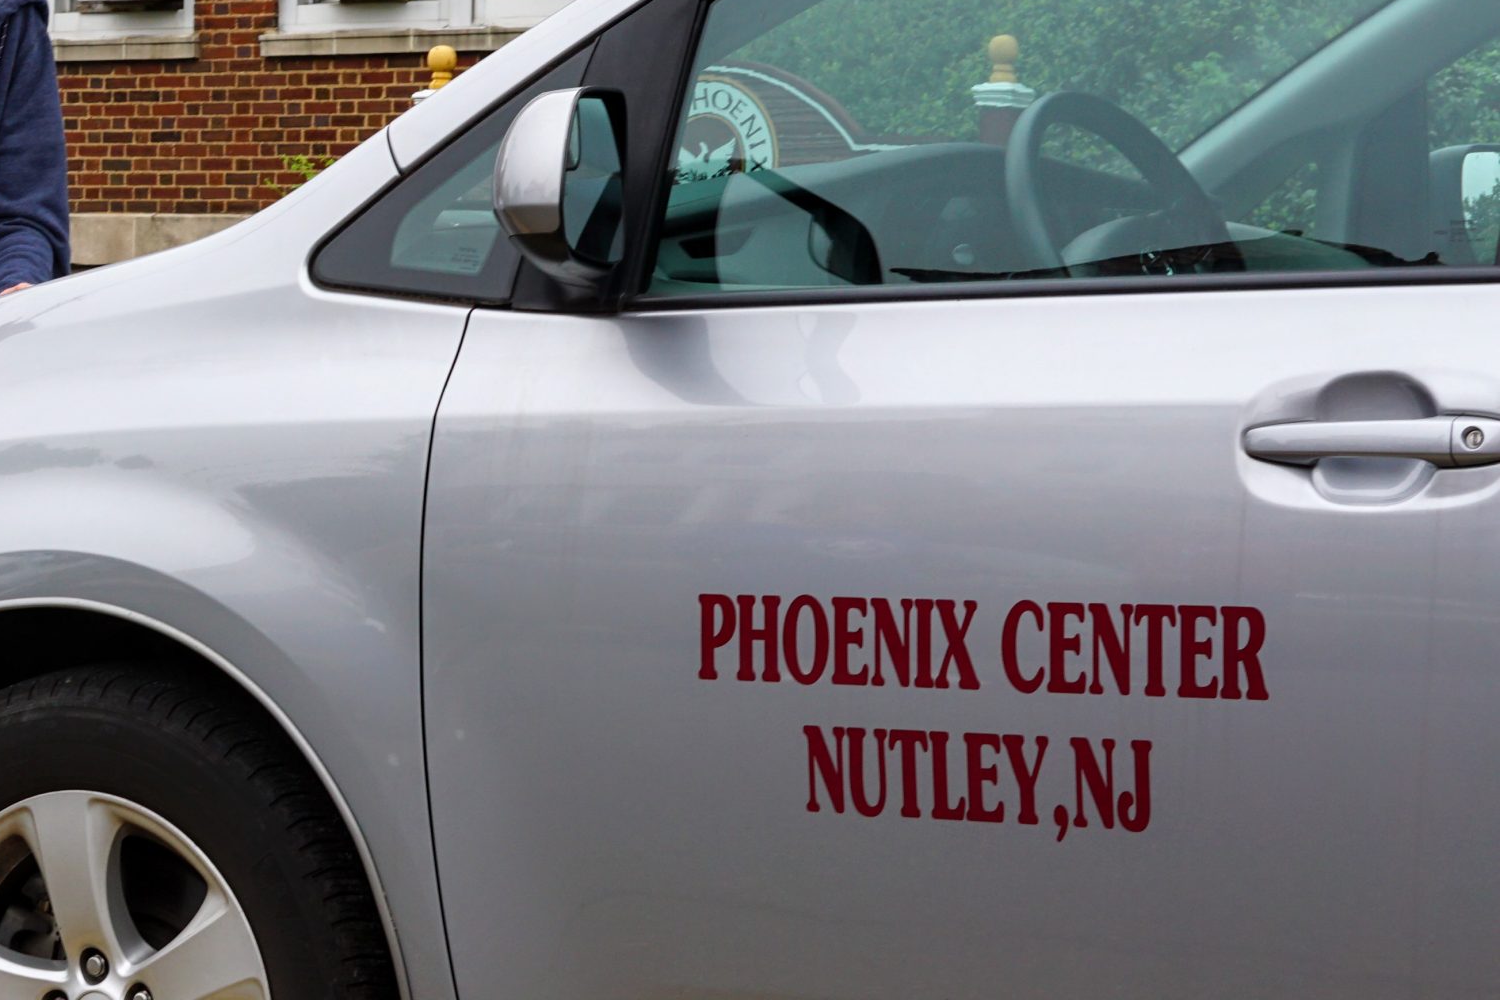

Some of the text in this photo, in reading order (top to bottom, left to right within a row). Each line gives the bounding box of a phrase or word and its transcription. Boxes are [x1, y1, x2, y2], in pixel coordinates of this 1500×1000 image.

[692, 86, 769, 172] HOENIX
[698, 593, 1269, 701] PHOENIX CENTER
